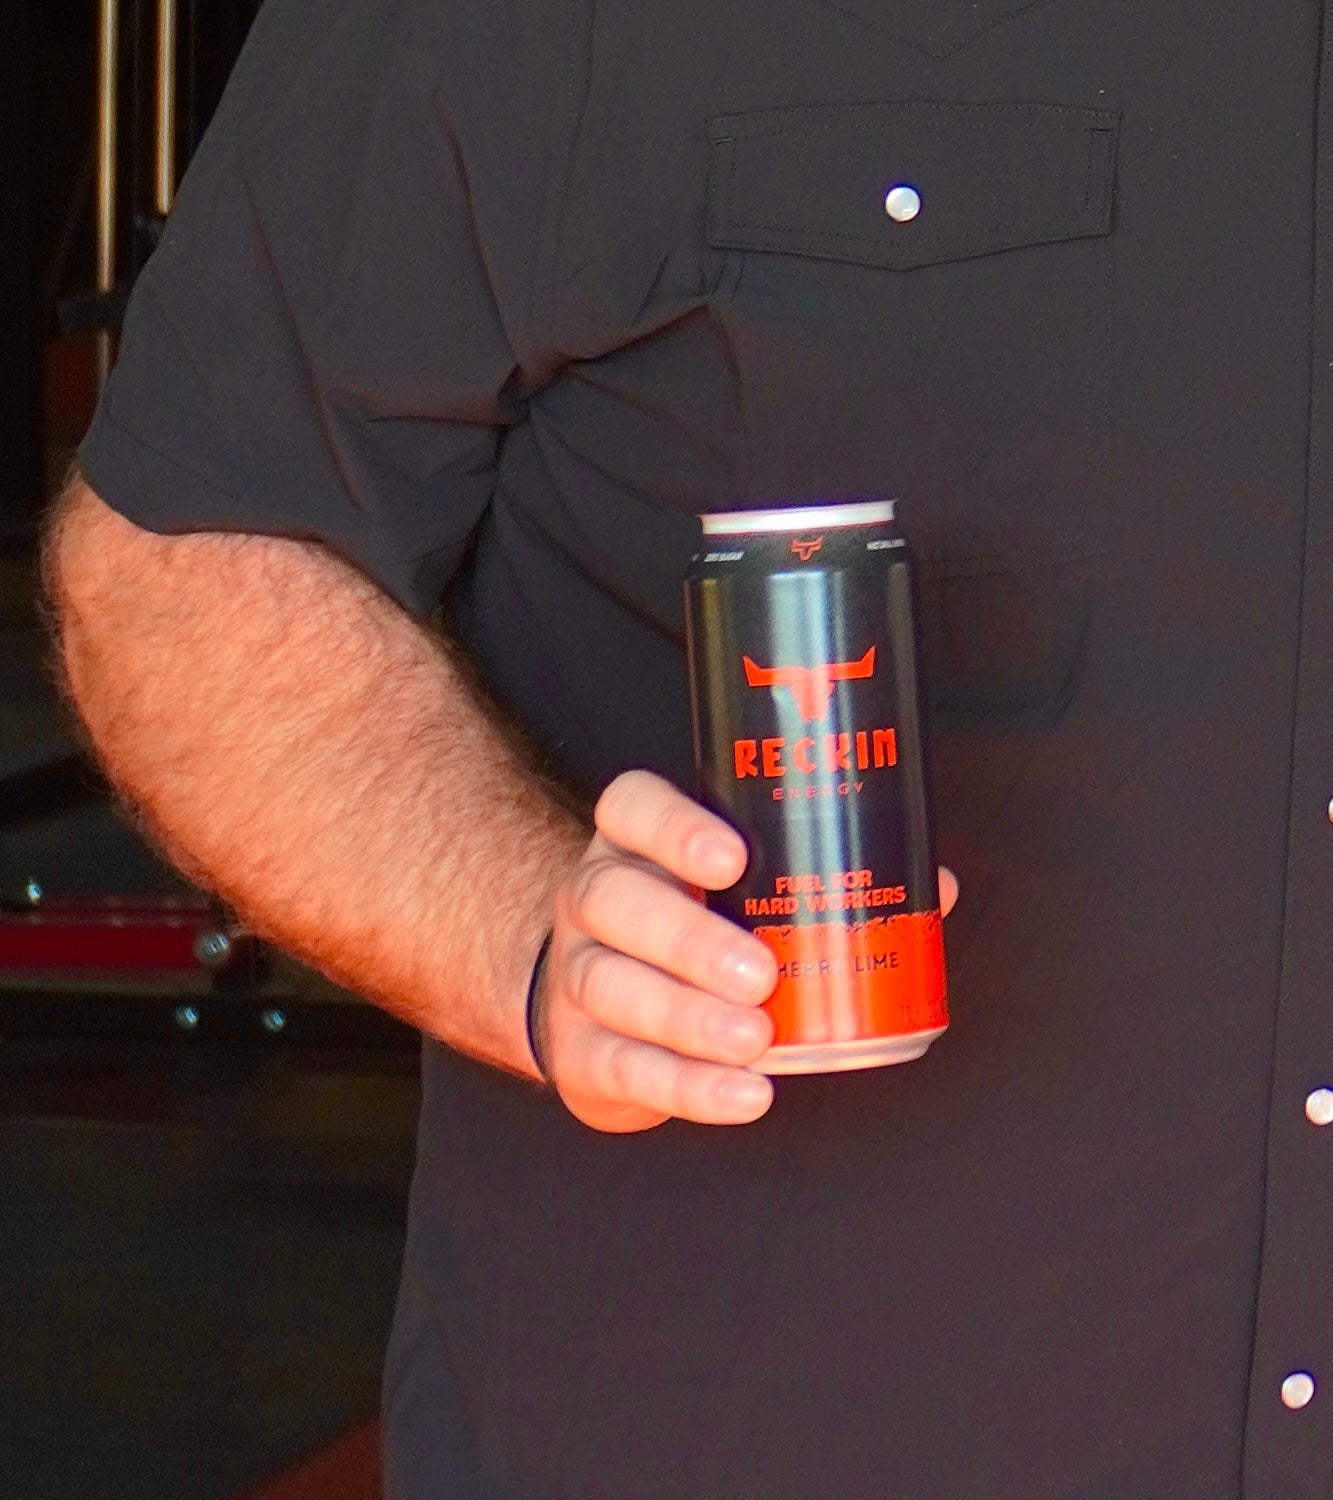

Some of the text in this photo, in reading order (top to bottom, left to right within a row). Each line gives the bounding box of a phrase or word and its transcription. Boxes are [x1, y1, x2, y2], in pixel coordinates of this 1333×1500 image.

[734, 727, 898, 779] RECKIN
[771, 781, 864, 801] ENERGY
[775, 869, 873, 895] FUEL FOR
[744, 885, 907, 916] HARD WORKERS
[854, 951, 901, 973] LIME
